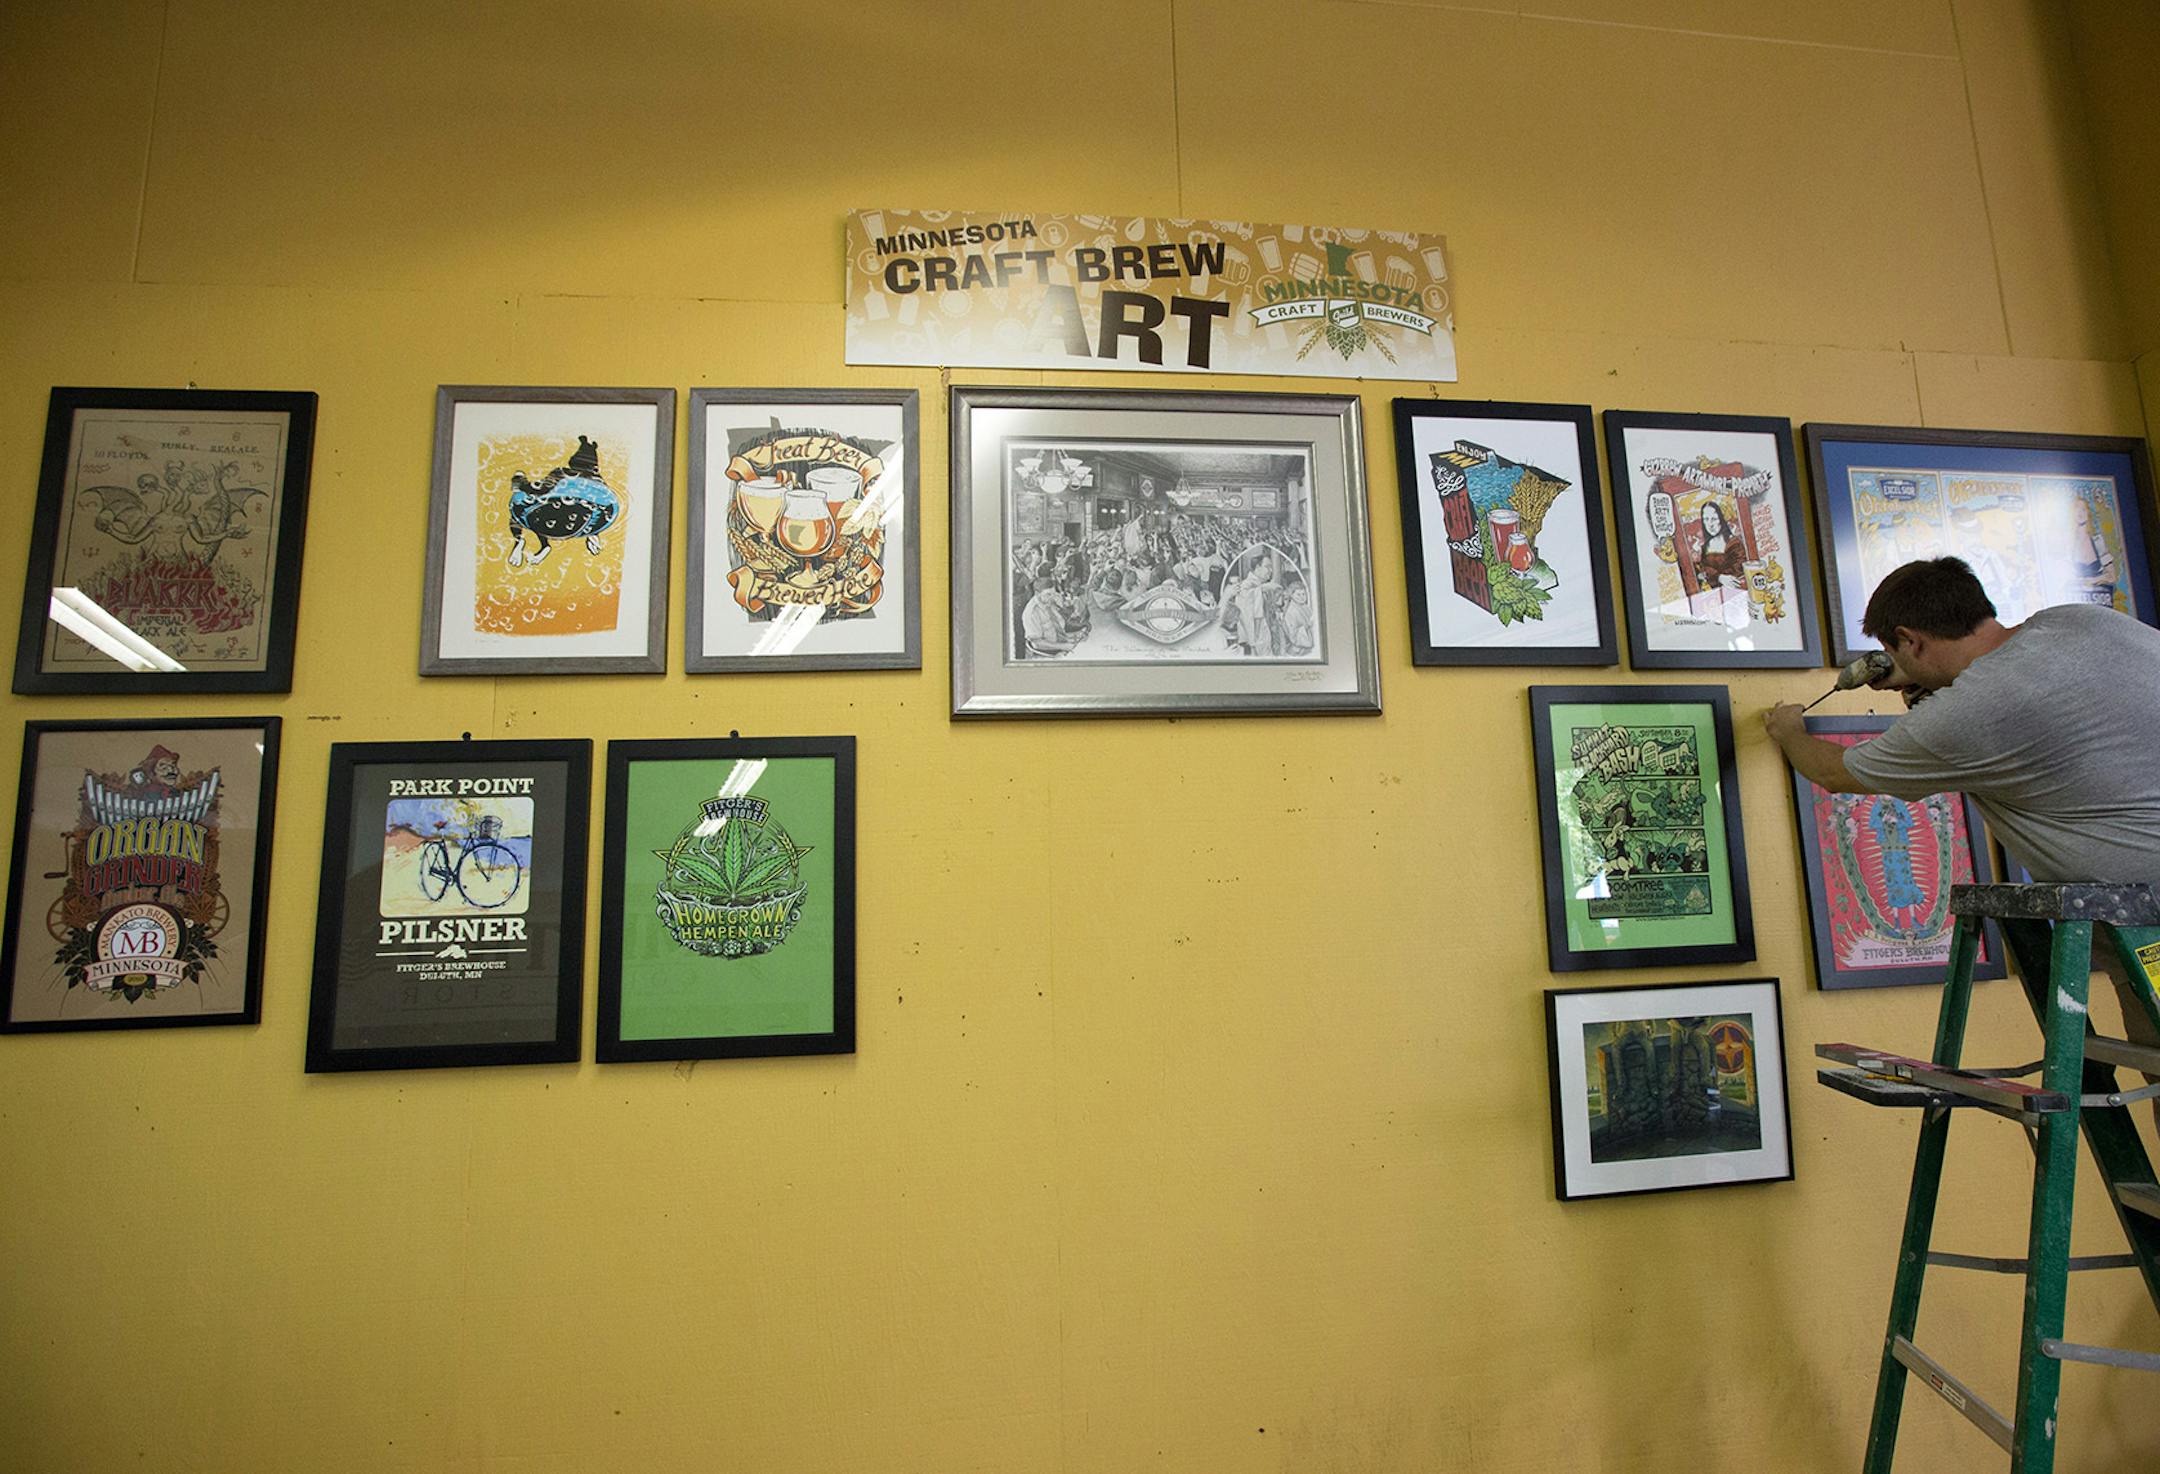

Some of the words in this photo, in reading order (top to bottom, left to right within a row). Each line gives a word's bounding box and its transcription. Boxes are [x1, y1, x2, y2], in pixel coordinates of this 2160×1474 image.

[875, 218, 1038, 256] MINNESOTA
[884, 250, 1056, 295] CRAFT
[1076, 241, 1227, 283] BREW
[1264, 278, 1424, 313] MINNESOTA
[1036, 283, 1230, 369] ART
[1267, 302, 1318, 318] CRAFT
[1366, 306, 1426, 329] BREWERS
[809, 436, 862, 467] Beer
[752, 579, 828, 604] Brewed
[830, 571, 875, 598] Here
[1572, 724, 1610, 758] SUMMIT
[1598, 747, 1640, 783] BASH
[389, 779, 453, 796] PARK
[457, 778, 535, 795] POINT
[705, 798, 763, 814] FITGER'S
[88, 818, 207, 865] ORGAN
[83, 855, 203, 898] GRINDER
[101, 907, 145, 950] MANKATO
[146, 907, 177, 948] BREWERY
[675, 903, 788, 926] HOMEGROWN
[117, 931, 160, 955] MB
[378, 917, 528, 944] PILSNER
[681, 925, 750, 941] HEMPEN
[751, 924, 783, 939] ALE
[91, 959, 182, 977] MINNESOTA
[396, 962, 443, 973] FITGER'S
[444, 961, 507, 971] BREWHOUSE
[464, 970, 483, 980] MN
